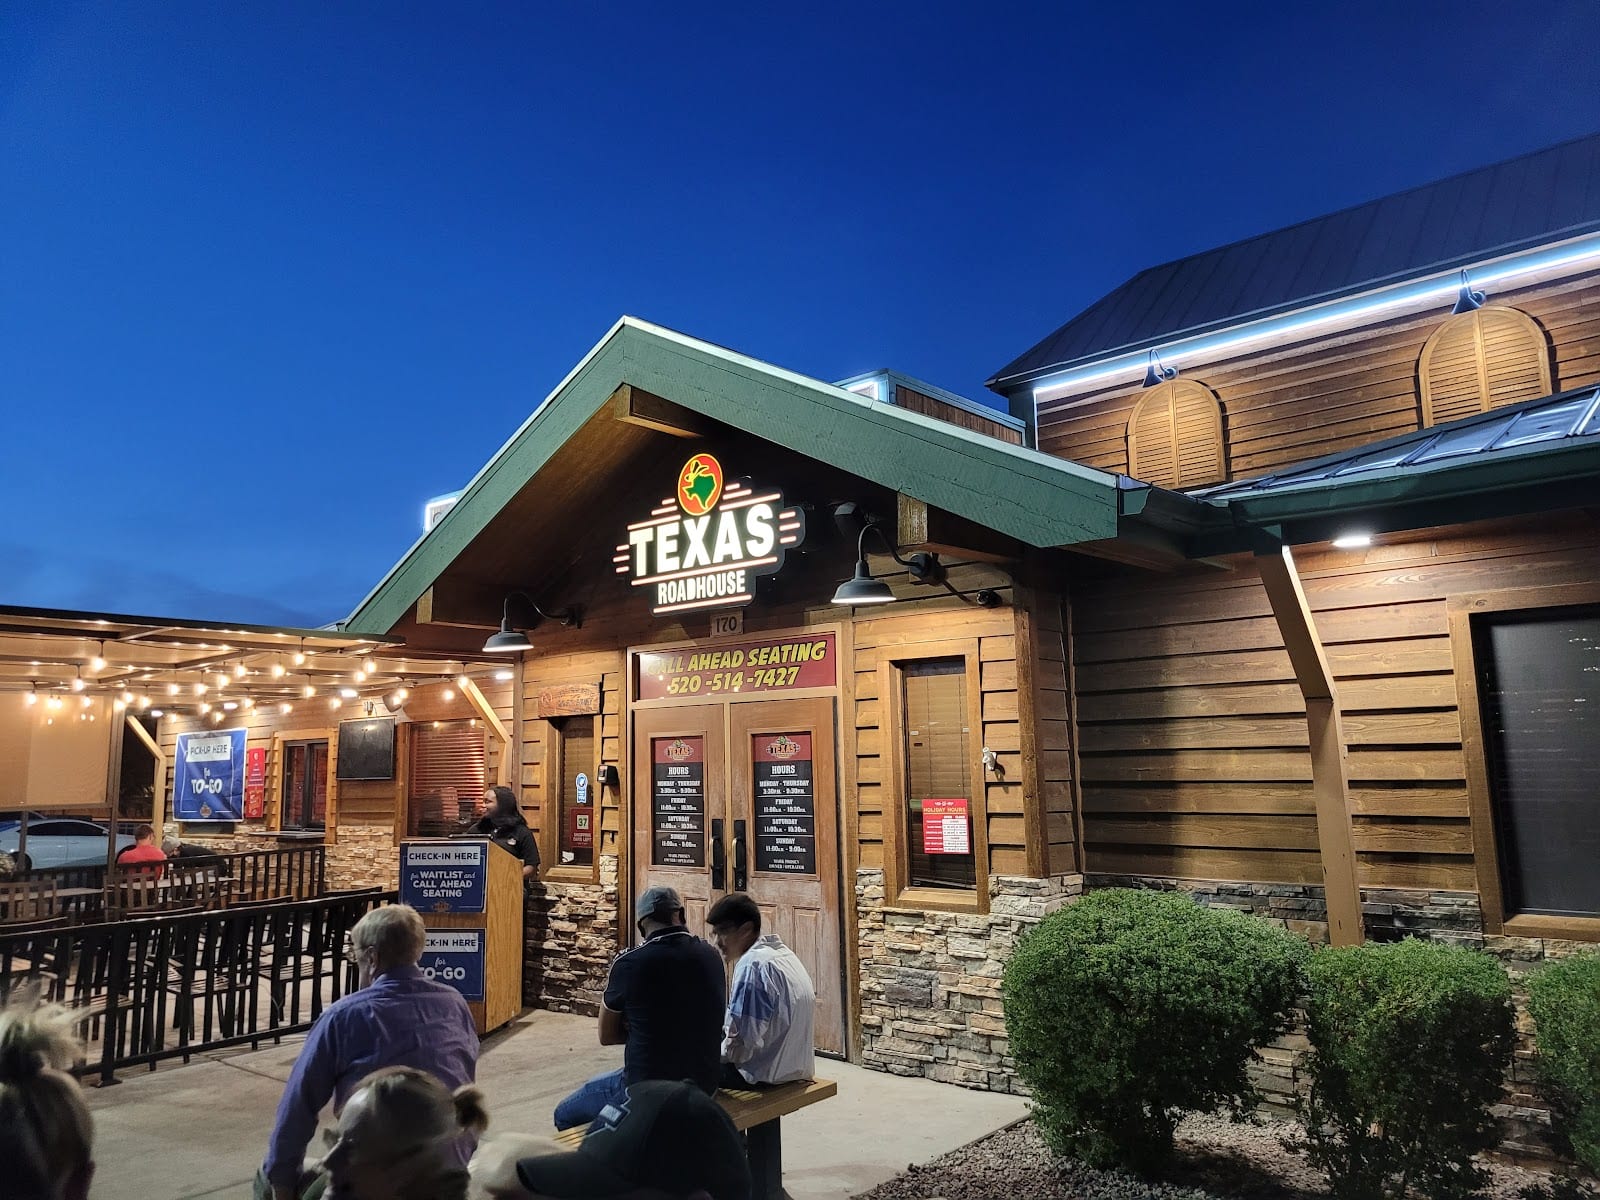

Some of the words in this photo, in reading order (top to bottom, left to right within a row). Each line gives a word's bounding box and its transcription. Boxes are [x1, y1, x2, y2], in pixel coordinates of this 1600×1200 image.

[629, 503, 775, 577] TEXAS
[657, 570, 746, 605] ROADHOUSE
[716, 616, 737, 632] 170
[648, 656, 683, 674] CALL
[687, 651, 744, 672] AHEAD
[747, 641, 826, 667] SEATING
[669, 676, 700, 695] 520
[190, 746, 211, 755] PICK-UP
[212, 744, 228, 753] HERE
[771, 744, 798, 754] TEXAS
[668, 766, 689, 775] HOURS
[771, 764, 796, 775] HOURS
[191, 778, 223, 794] TO-GO
[578, 817, 588, 827] 37
[775, 837, 796, 845] SUNDAY
[409, 852, 451, 860] CHECK-IN
[454, 852, 478, 860] HERE
[420, 871, 463, 879] WAITLIST
[412, 880, 437, 888] CALL
[439, 880, 473, 888] AHEAD
[422, 889, 463, 898] SEATING
[425, 938, 449, 947] CK-IN
[452, 938, 476, 947] HERE
